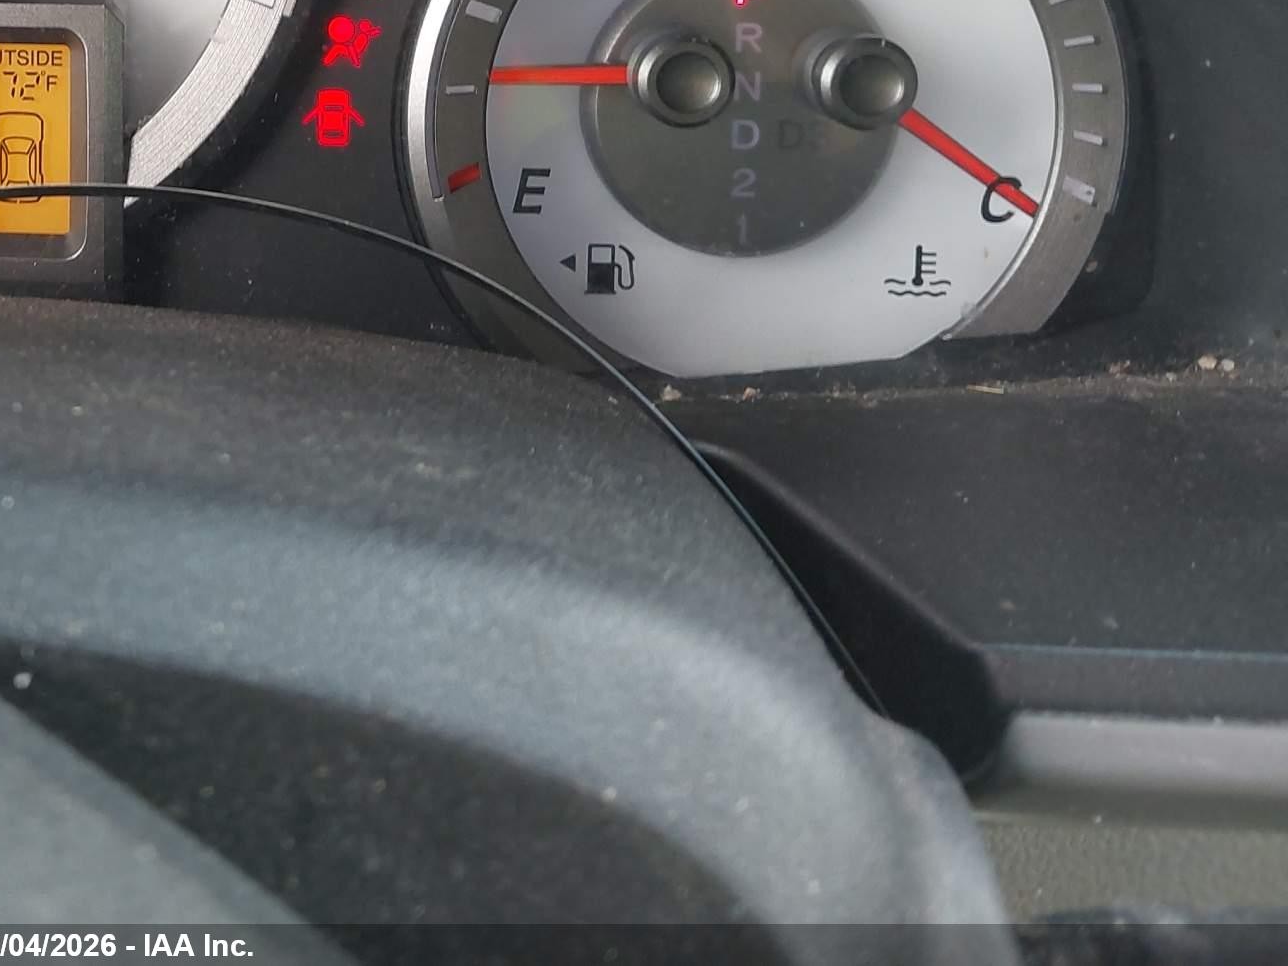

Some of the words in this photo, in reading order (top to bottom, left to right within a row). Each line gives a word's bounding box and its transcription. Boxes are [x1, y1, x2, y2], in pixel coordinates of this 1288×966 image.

[735, 23, 763, 53] R
[734, 71, 761, 101] N
[731, 120, 760, 150] D
[513, 168, 551, 214] E
[731, 168, 756, 198] 2
[980, 177, 1023, 223] C
